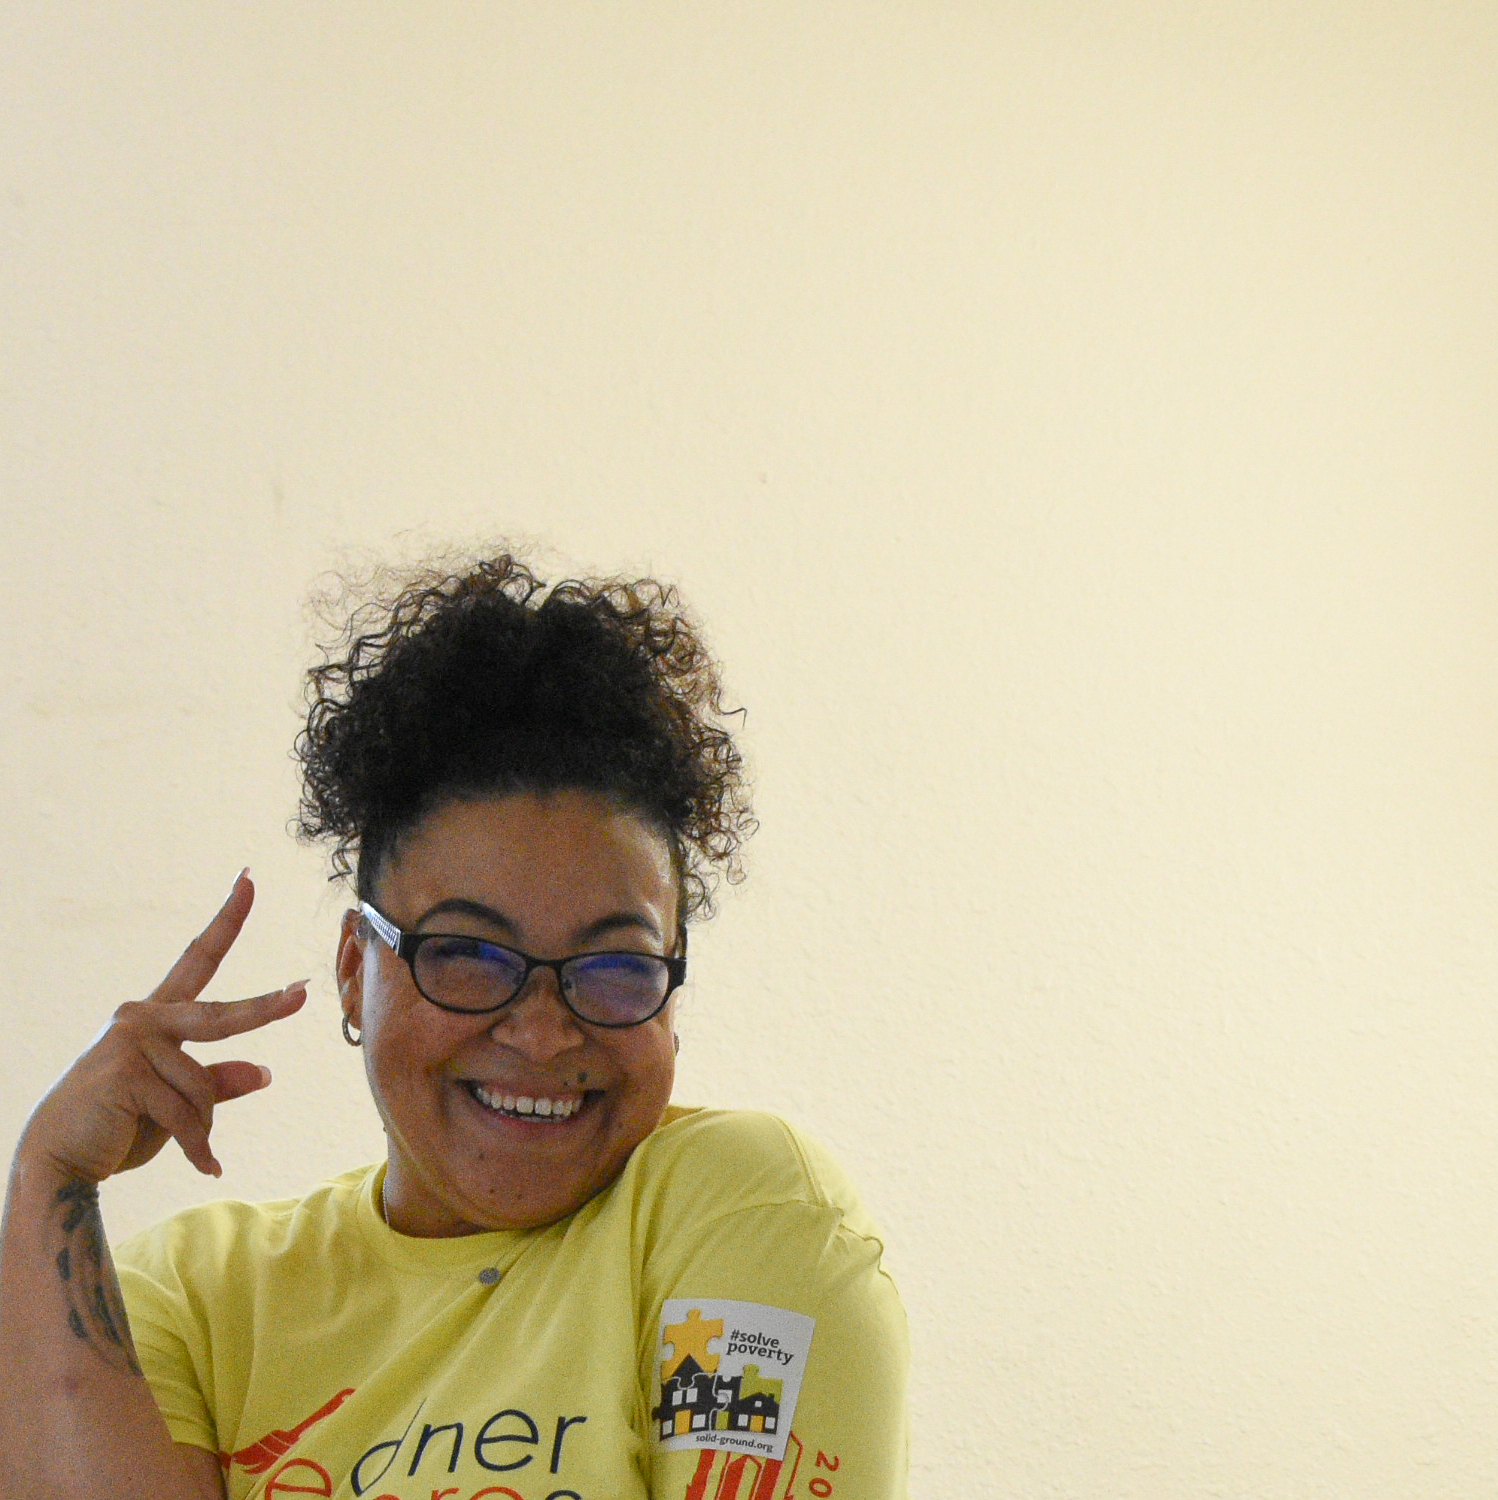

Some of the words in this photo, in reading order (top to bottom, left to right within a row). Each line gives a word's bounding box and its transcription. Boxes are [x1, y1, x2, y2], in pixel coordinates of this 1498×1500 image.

[730, 1329, 780, 1348] #solve
[726, 1342, 794, 1365] poverty
[695, 1433, 773, 1453] solid-ground.org
